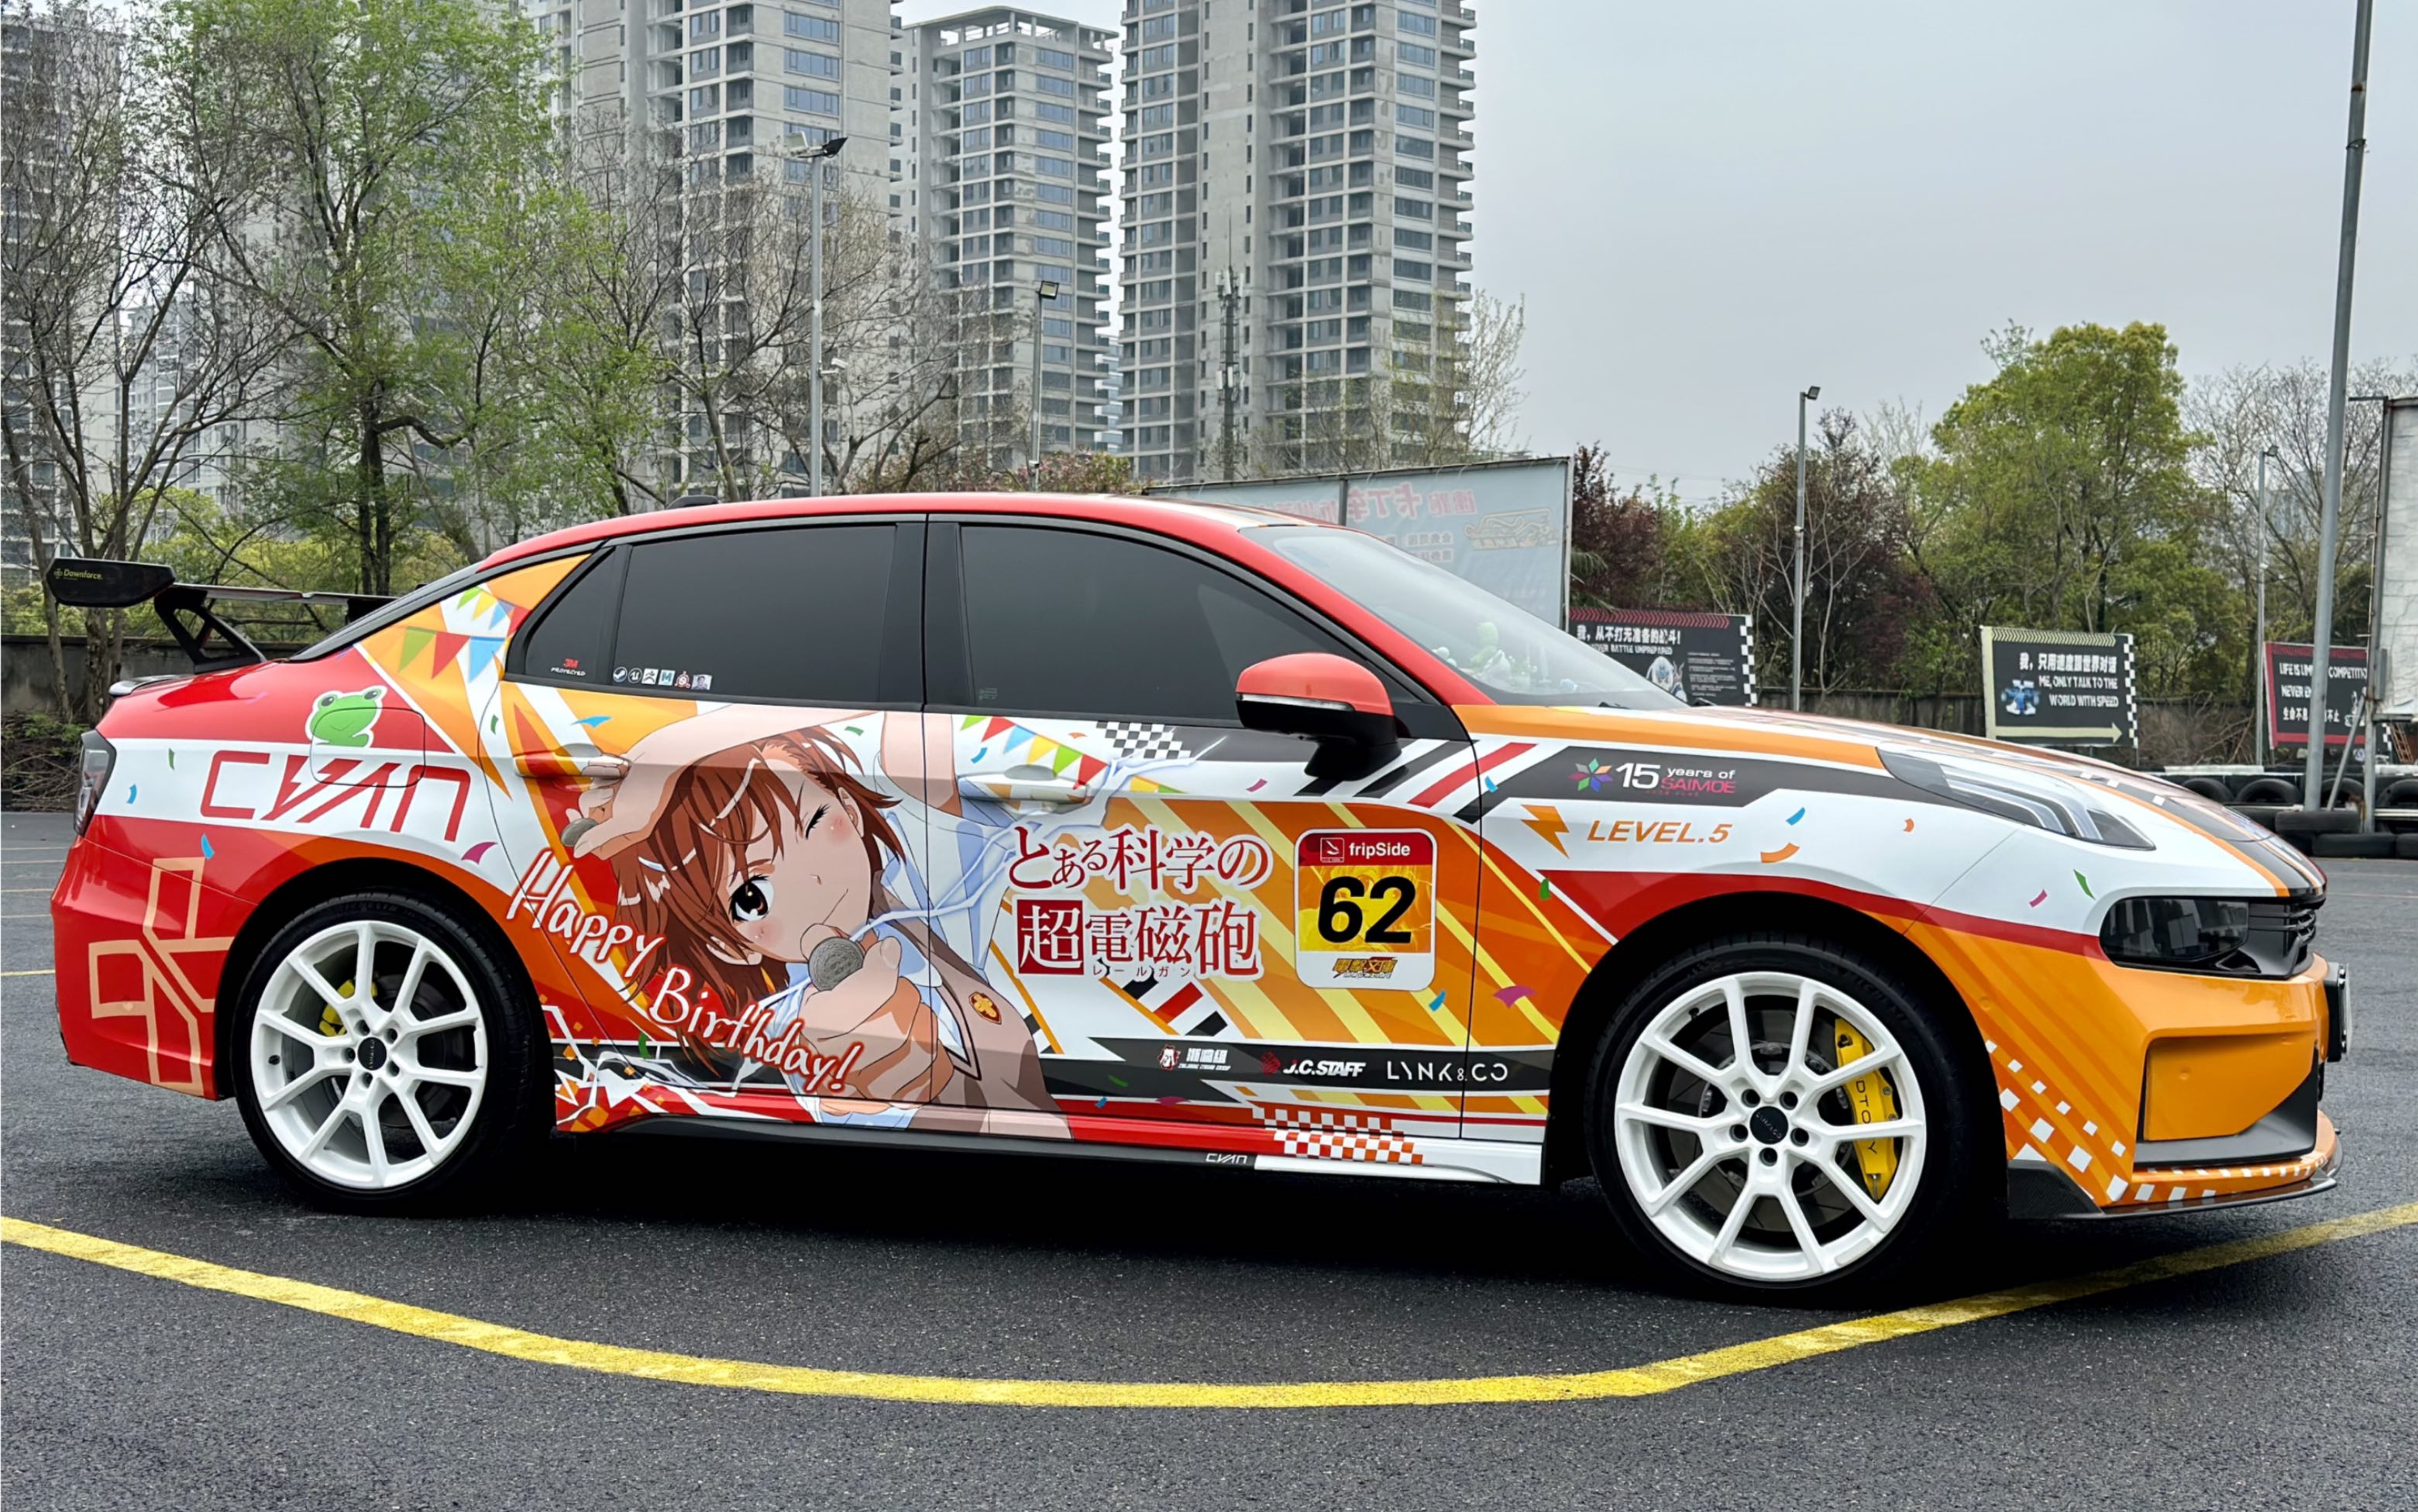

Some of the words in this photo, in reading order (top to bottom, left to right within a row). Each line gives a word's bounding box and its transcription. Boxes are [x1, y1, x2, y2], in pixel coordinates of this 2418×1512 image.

[2052, 675, 2072, 688] ONLY
[2072, 676, 2092, 689] TALK
[2092, 677, 2103, 689] TO
[2103, 677, 2118, 689] THE
[2281, 685, 2304, 698] NEVER
[2048, 694, 2076, 706] WORLD
[2076, 695, 2096, 707] WITH
[2096, 696, 2120, 707] SPEED
[1616, 762, 1661, 789] 15
[1667, 768, 1713, 778] years
[1718, 770, 1736, 780] of
[1661, 777, 1736, 794] SAIMOE
[1587, 820, 1733, 844] LEVEL.5
[1009, 826, 1269, 890] とある科学の
[1349, 842, 1411, 860] fripSide
[506, 850, 665, 978] Happy
[1318, 875, 1416, 943] 62
[1016, 900, 1260, 976] 超電磁砲
[649, 966, 860, 1091] Birthday!
[1282, 1059, 1367, 1077] J.C.STAFF
